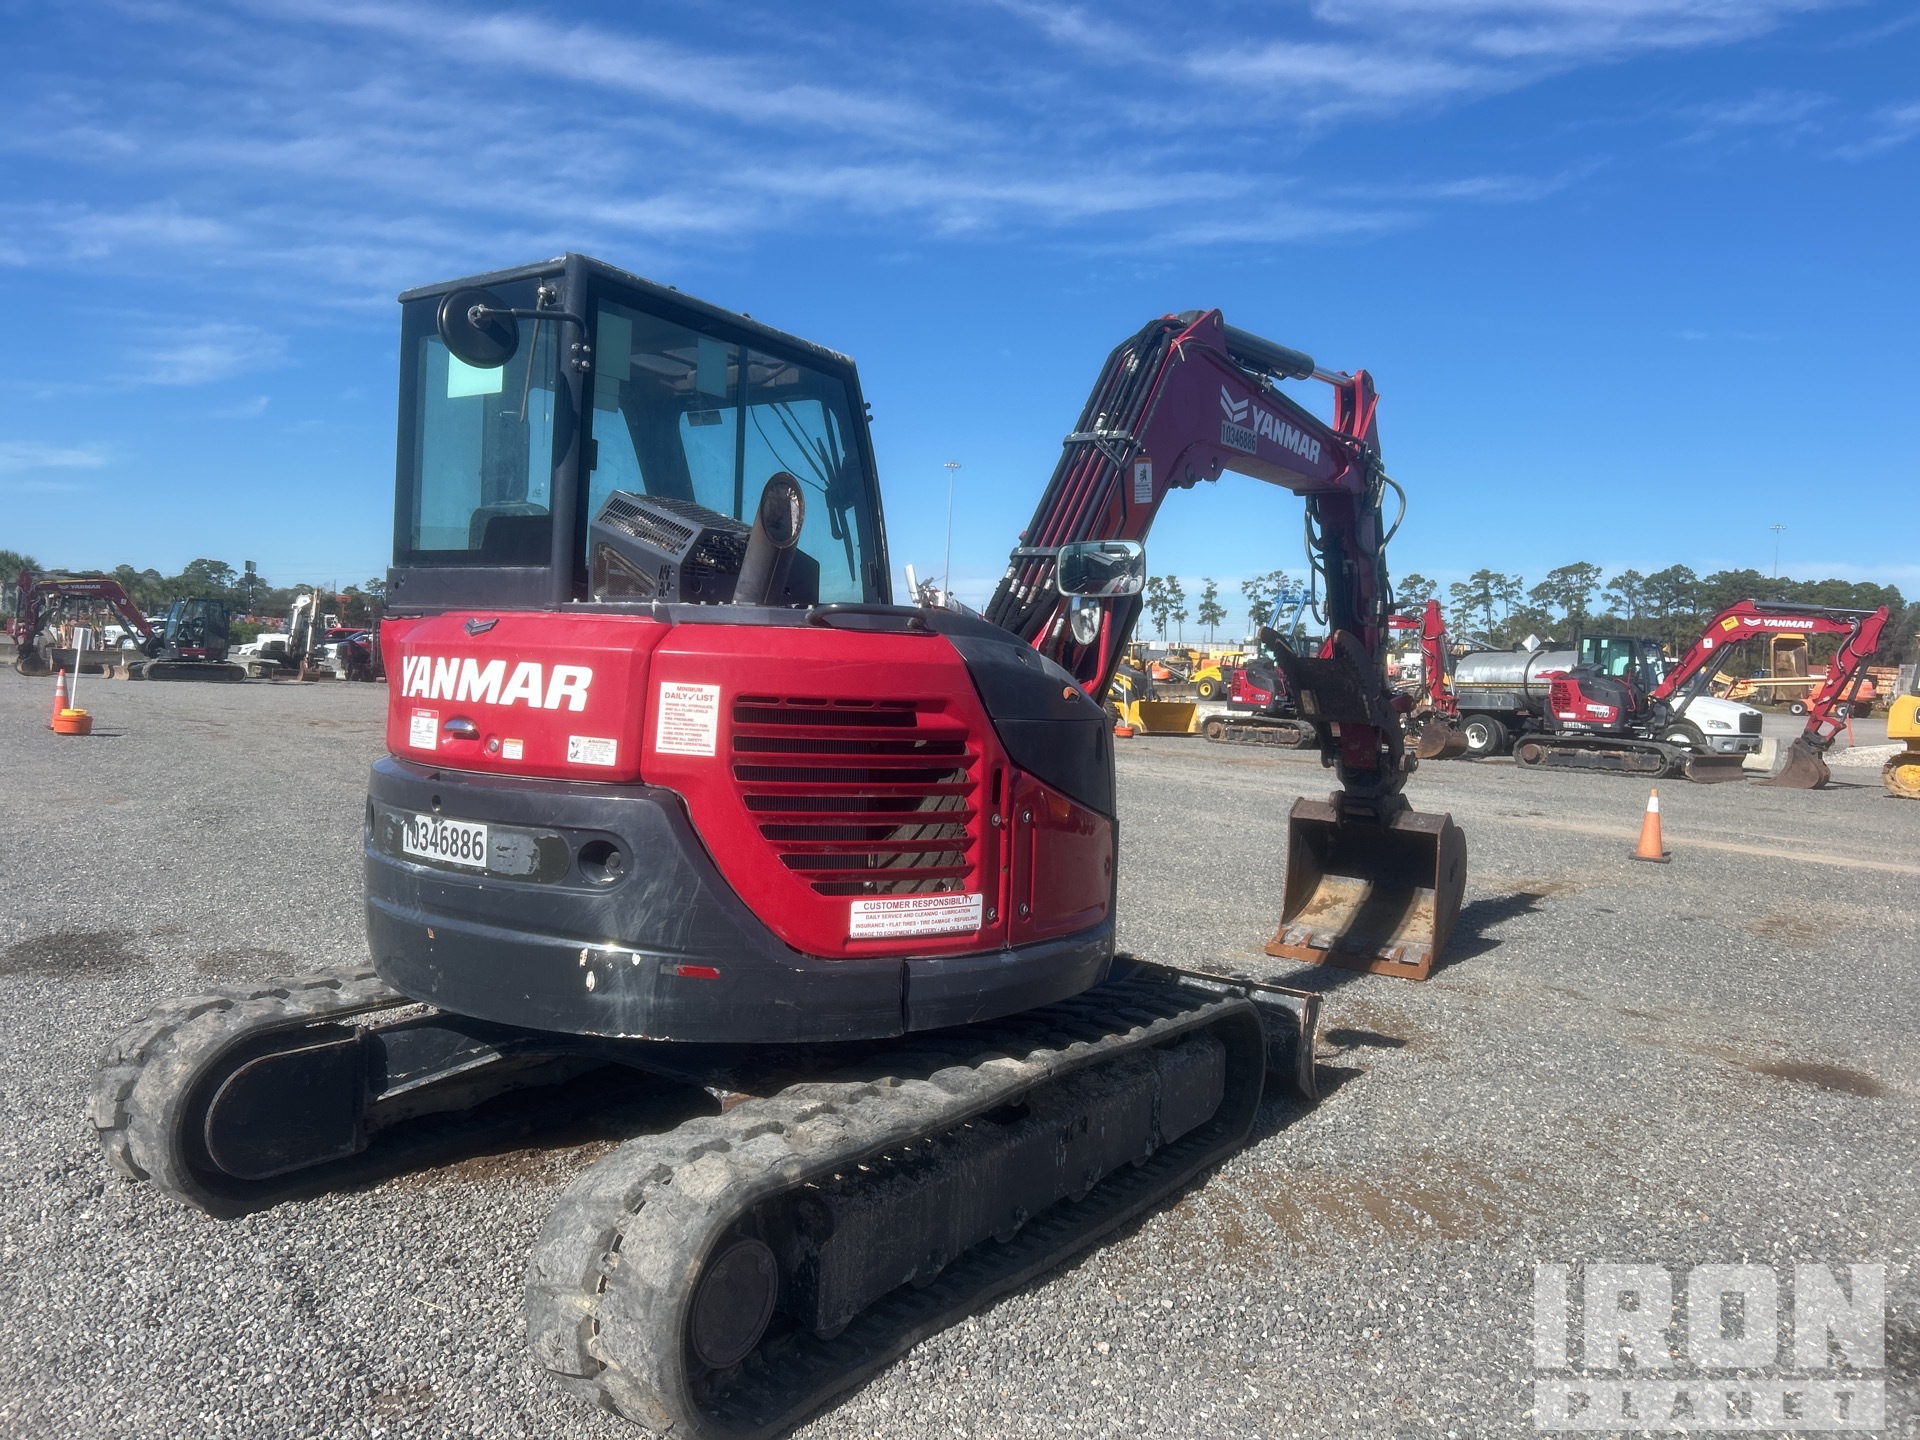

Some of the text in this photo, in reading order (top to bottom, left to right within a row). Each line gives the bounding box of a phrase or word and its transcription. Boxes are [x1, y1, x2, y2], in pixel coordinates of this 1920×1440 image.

[1252, 405, 1321, 464] YANMAR
[1763, 619, 1814, 629] YANMAR
[402, 656, 593, 712] YANMAR
[664, 692, 714, 702] DAILY LIST
[863, 896, 974, 911] CUSTOMER RESPONSIBILITY
